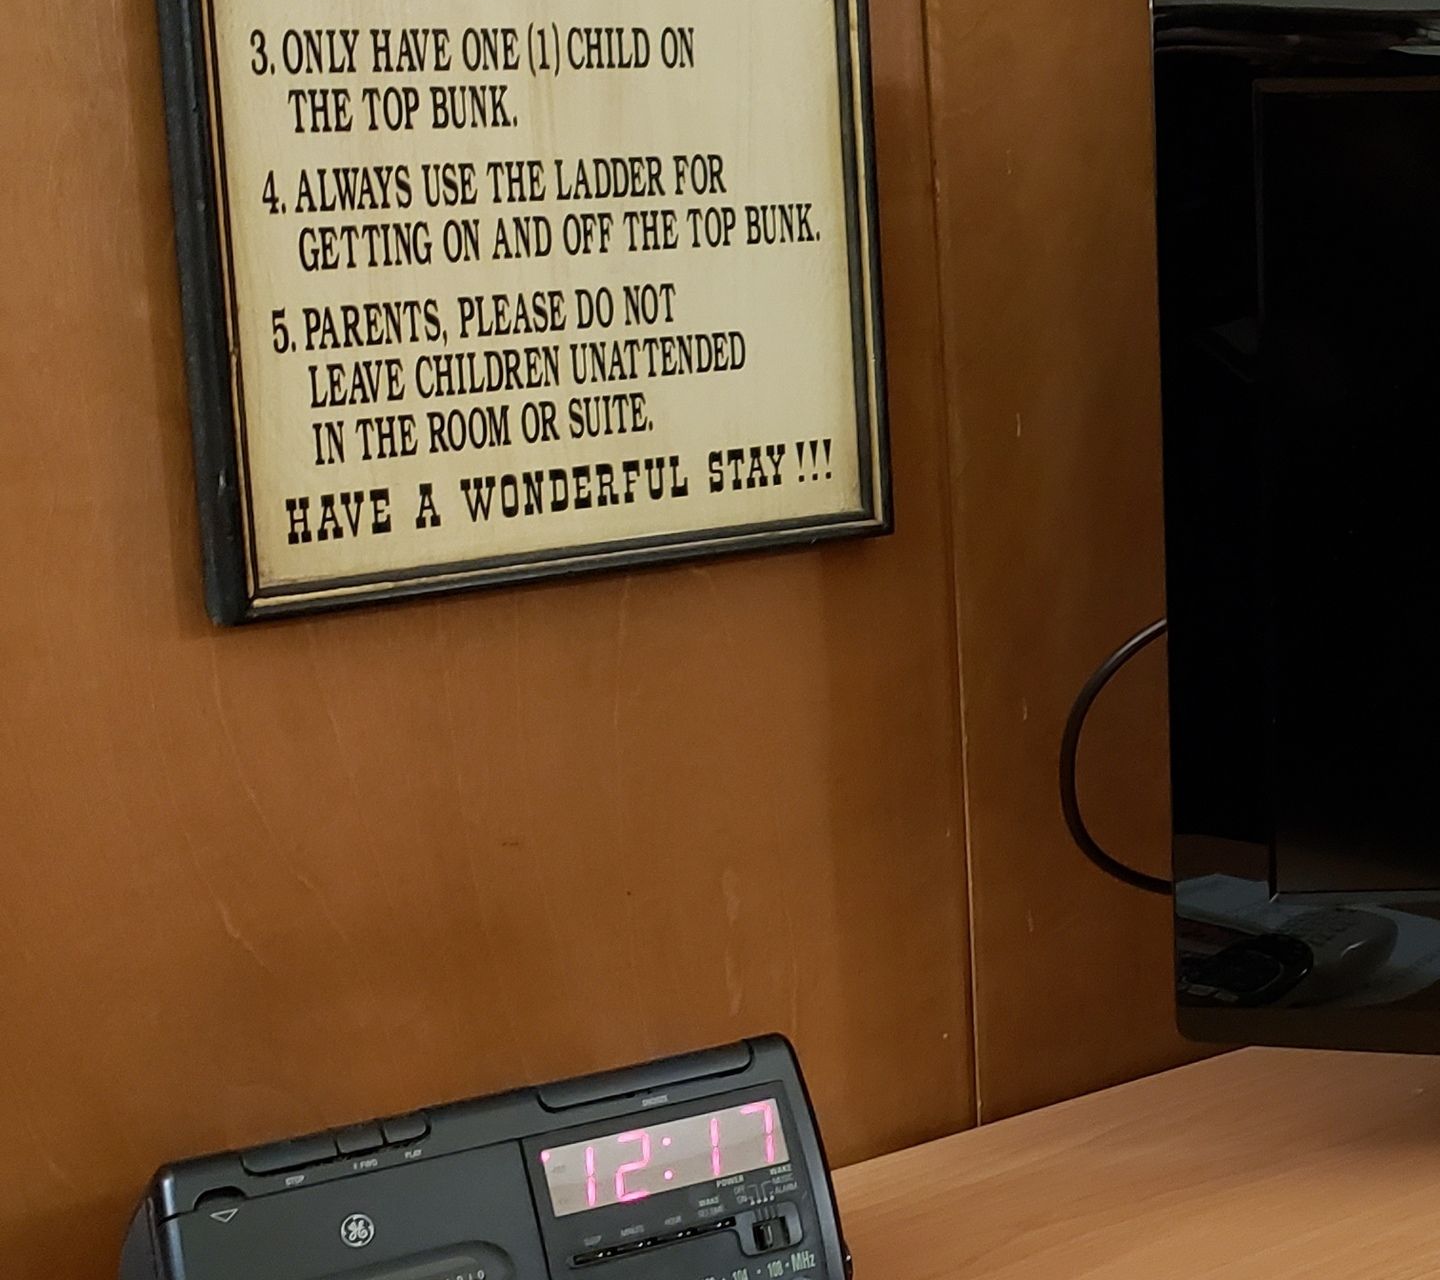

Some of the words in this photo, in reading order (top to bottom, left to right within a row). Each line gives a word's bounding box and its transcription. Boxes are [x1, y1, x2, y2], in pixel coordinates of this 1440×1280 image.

[250, 29, 275, 76] 3.
[283, 29, 359, 75] ONLY
[370, 28, 451, 72] HAVE
[462, 27, 520, 71] ONE
[528, 22, 560, 77] (1)
[567, 27, 650, 70] CHILD
[661, 27, 694, 69] ON
[288, 89, 353, 133] THE
[362, 87, 419, 131] TOP
[430, 85, 518, 129] BUNK.
[262, 170, 286, 215] 4.
[295, 165, 412, 213] ALWAYS
[421, 163, 477, 207] USE
[487, 160, 546, 203] THE
[554, 156, 665, 200] LADDER
[673, 154, 727, 195] FOR
[299, 221, 432, 272] GETTING
[443, 219, 480, 263] ON
[492, 216, 552, 260] AND
[563, 213, 613, 255] OFF
[623, 210, 678, 252] THE
[687, 207, 736, 248] TOP
[745, 203, 820, 245] BUNK.
[272, 308, 296, 354] 5.
[302, 298, 447, 350] PARENTS,
[457, 290, 566, 338] PLEASE
[575, 287, 614, 329] DO
[623, 283, 676, 325] NOT
[308, 359, 405, 408] LEAVE
[416, 346, 559, 398] CHILDREN
[570, 331, 746, 384] UNATTENDED
[312, 421, 345, 466] IN
[356, 415, 417, 461] THE
[427, 405, 511, 453] ROOM
[521, 401, 560, 443] OR
[569, 392, 653, 439] SUITE.
[285, 488, 391, 545] HAVE
[416, 483, 441, 529] A
[460, 455, 688, 522] WONDERFUL
[585, 1102, 775, 1207] 12:17
[791, 1250, 816, 1272] MHz
